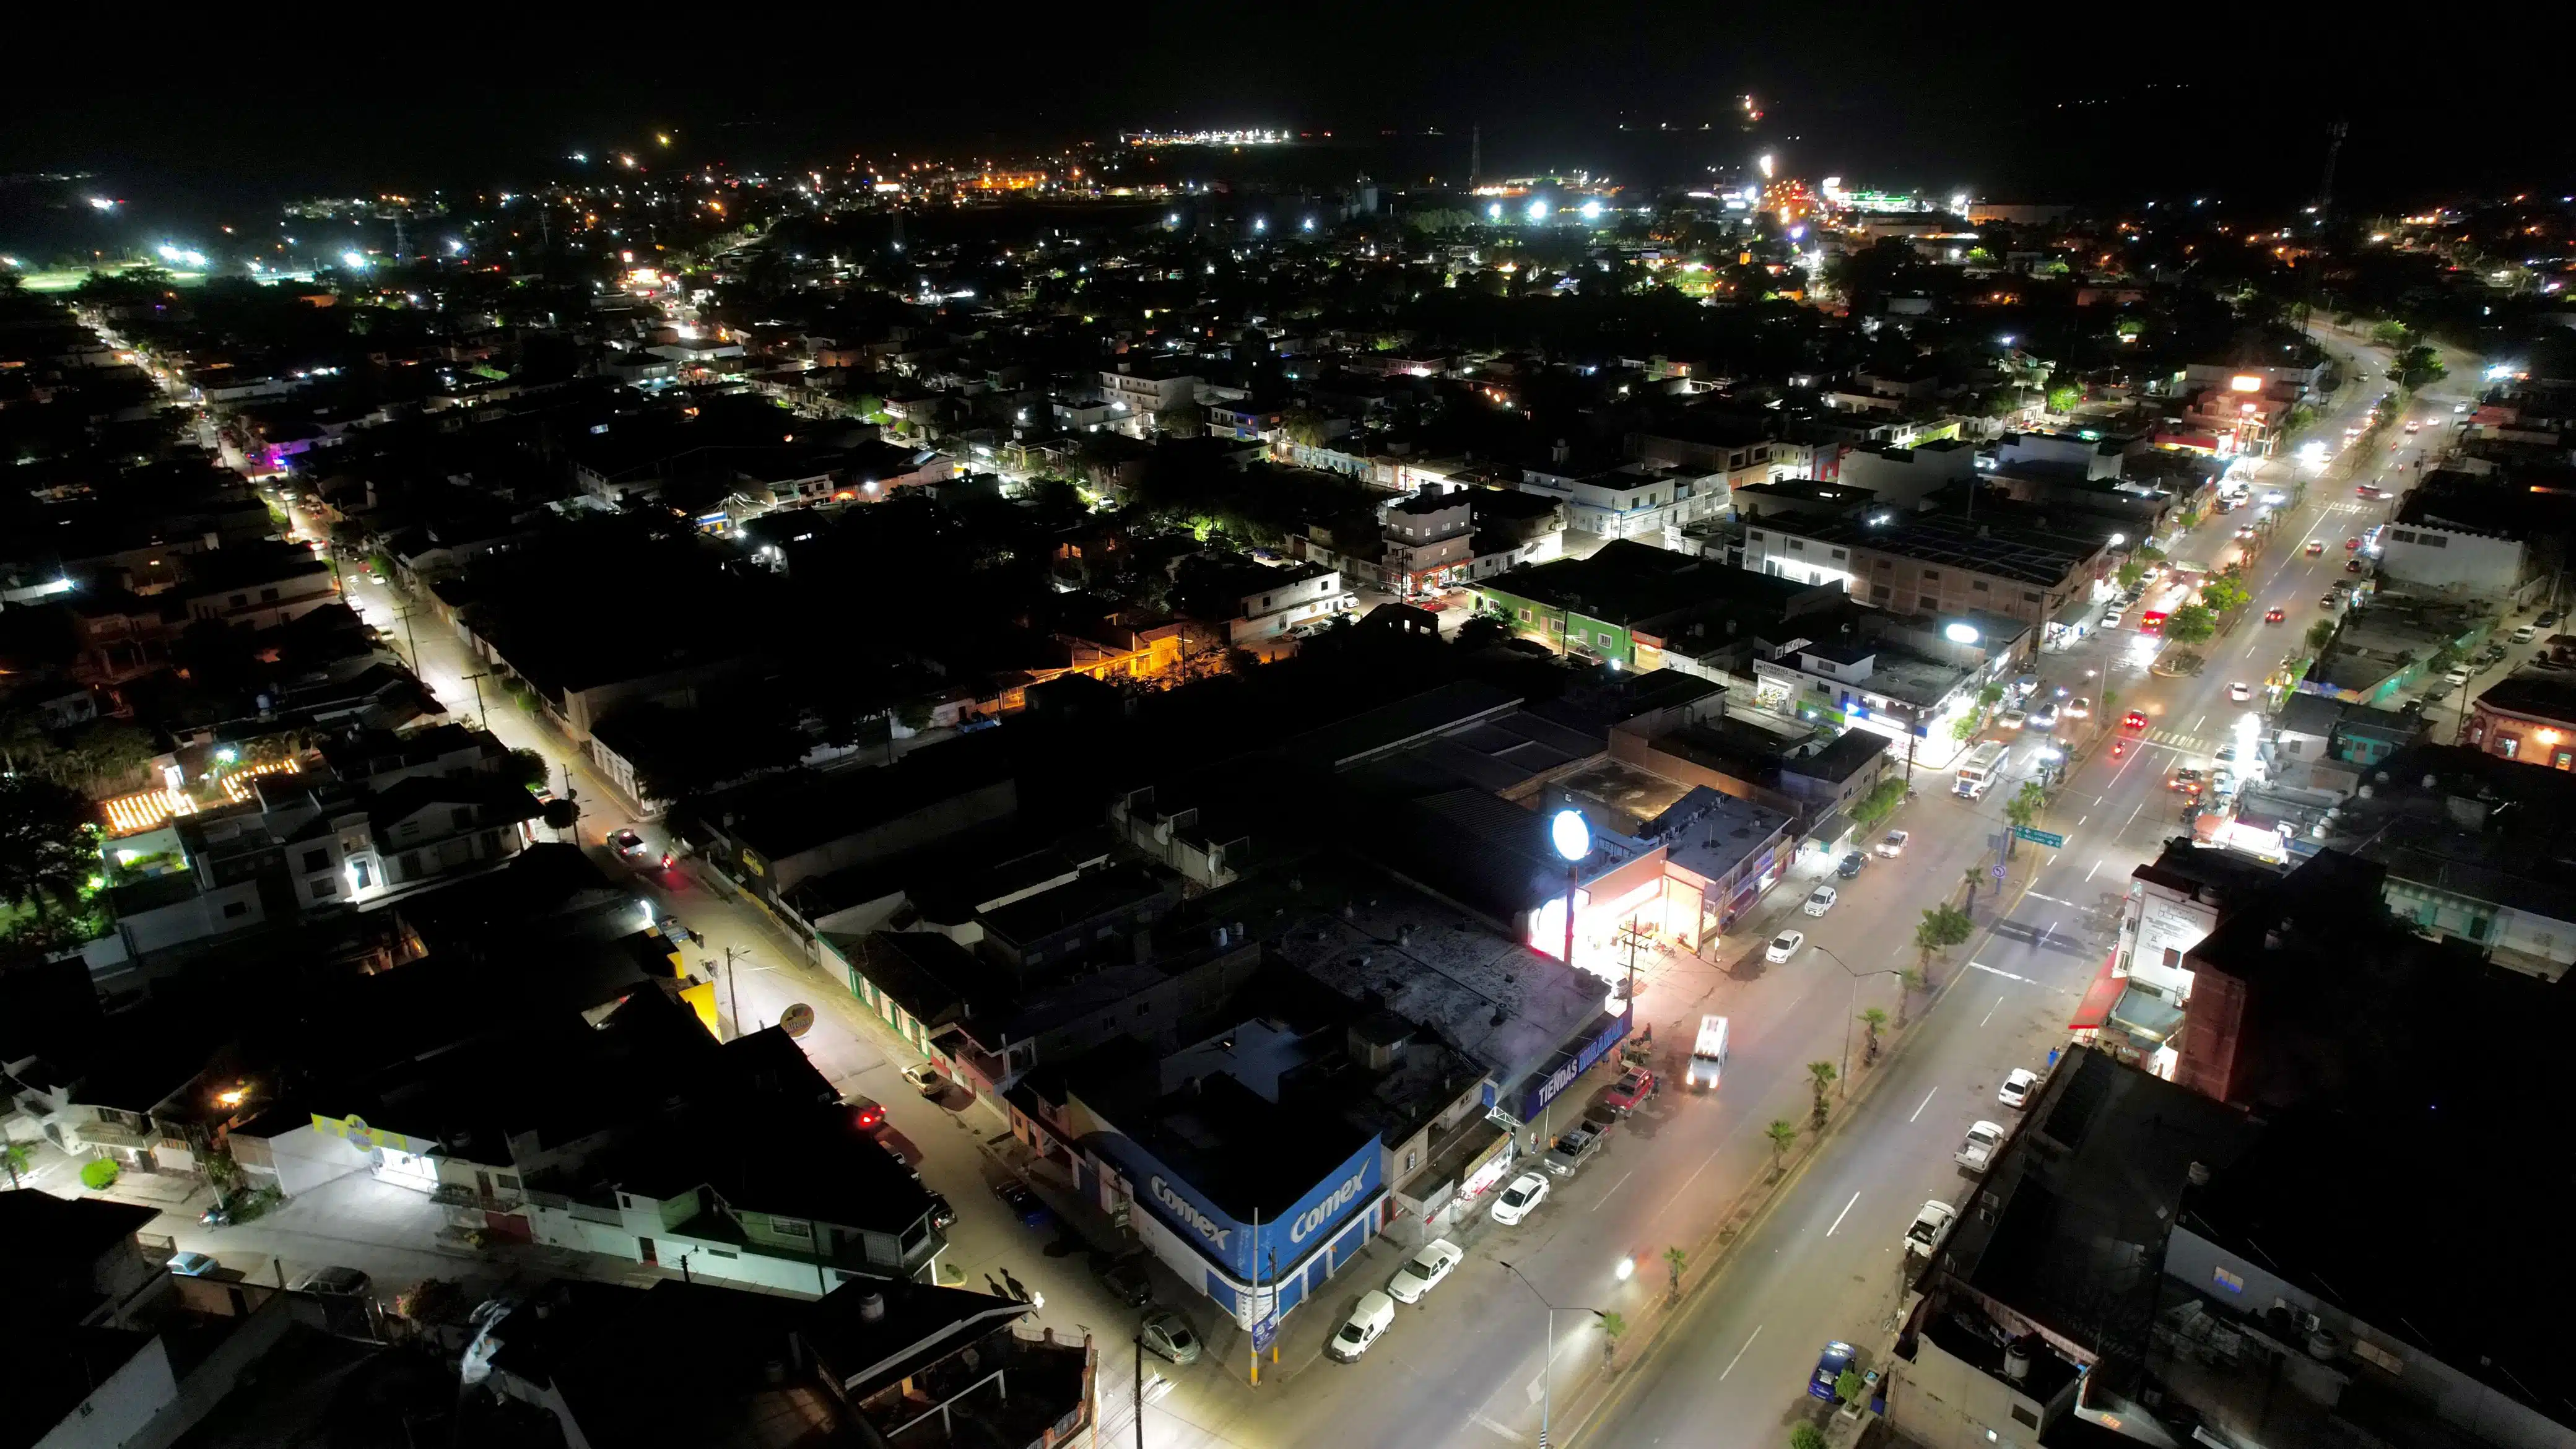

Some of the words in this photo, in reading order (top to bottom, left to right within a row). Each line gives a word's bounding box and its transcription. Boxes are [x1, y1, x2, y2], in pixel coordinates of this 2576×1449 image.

[1539, 1060, 1577, 1107] TIENDAS
[1578, 1018, 1624, 1073] MIRAMAR
[1151, 1175, 1232, 1251] Comex
[1290, 1156, 1372, 1243] Comex
